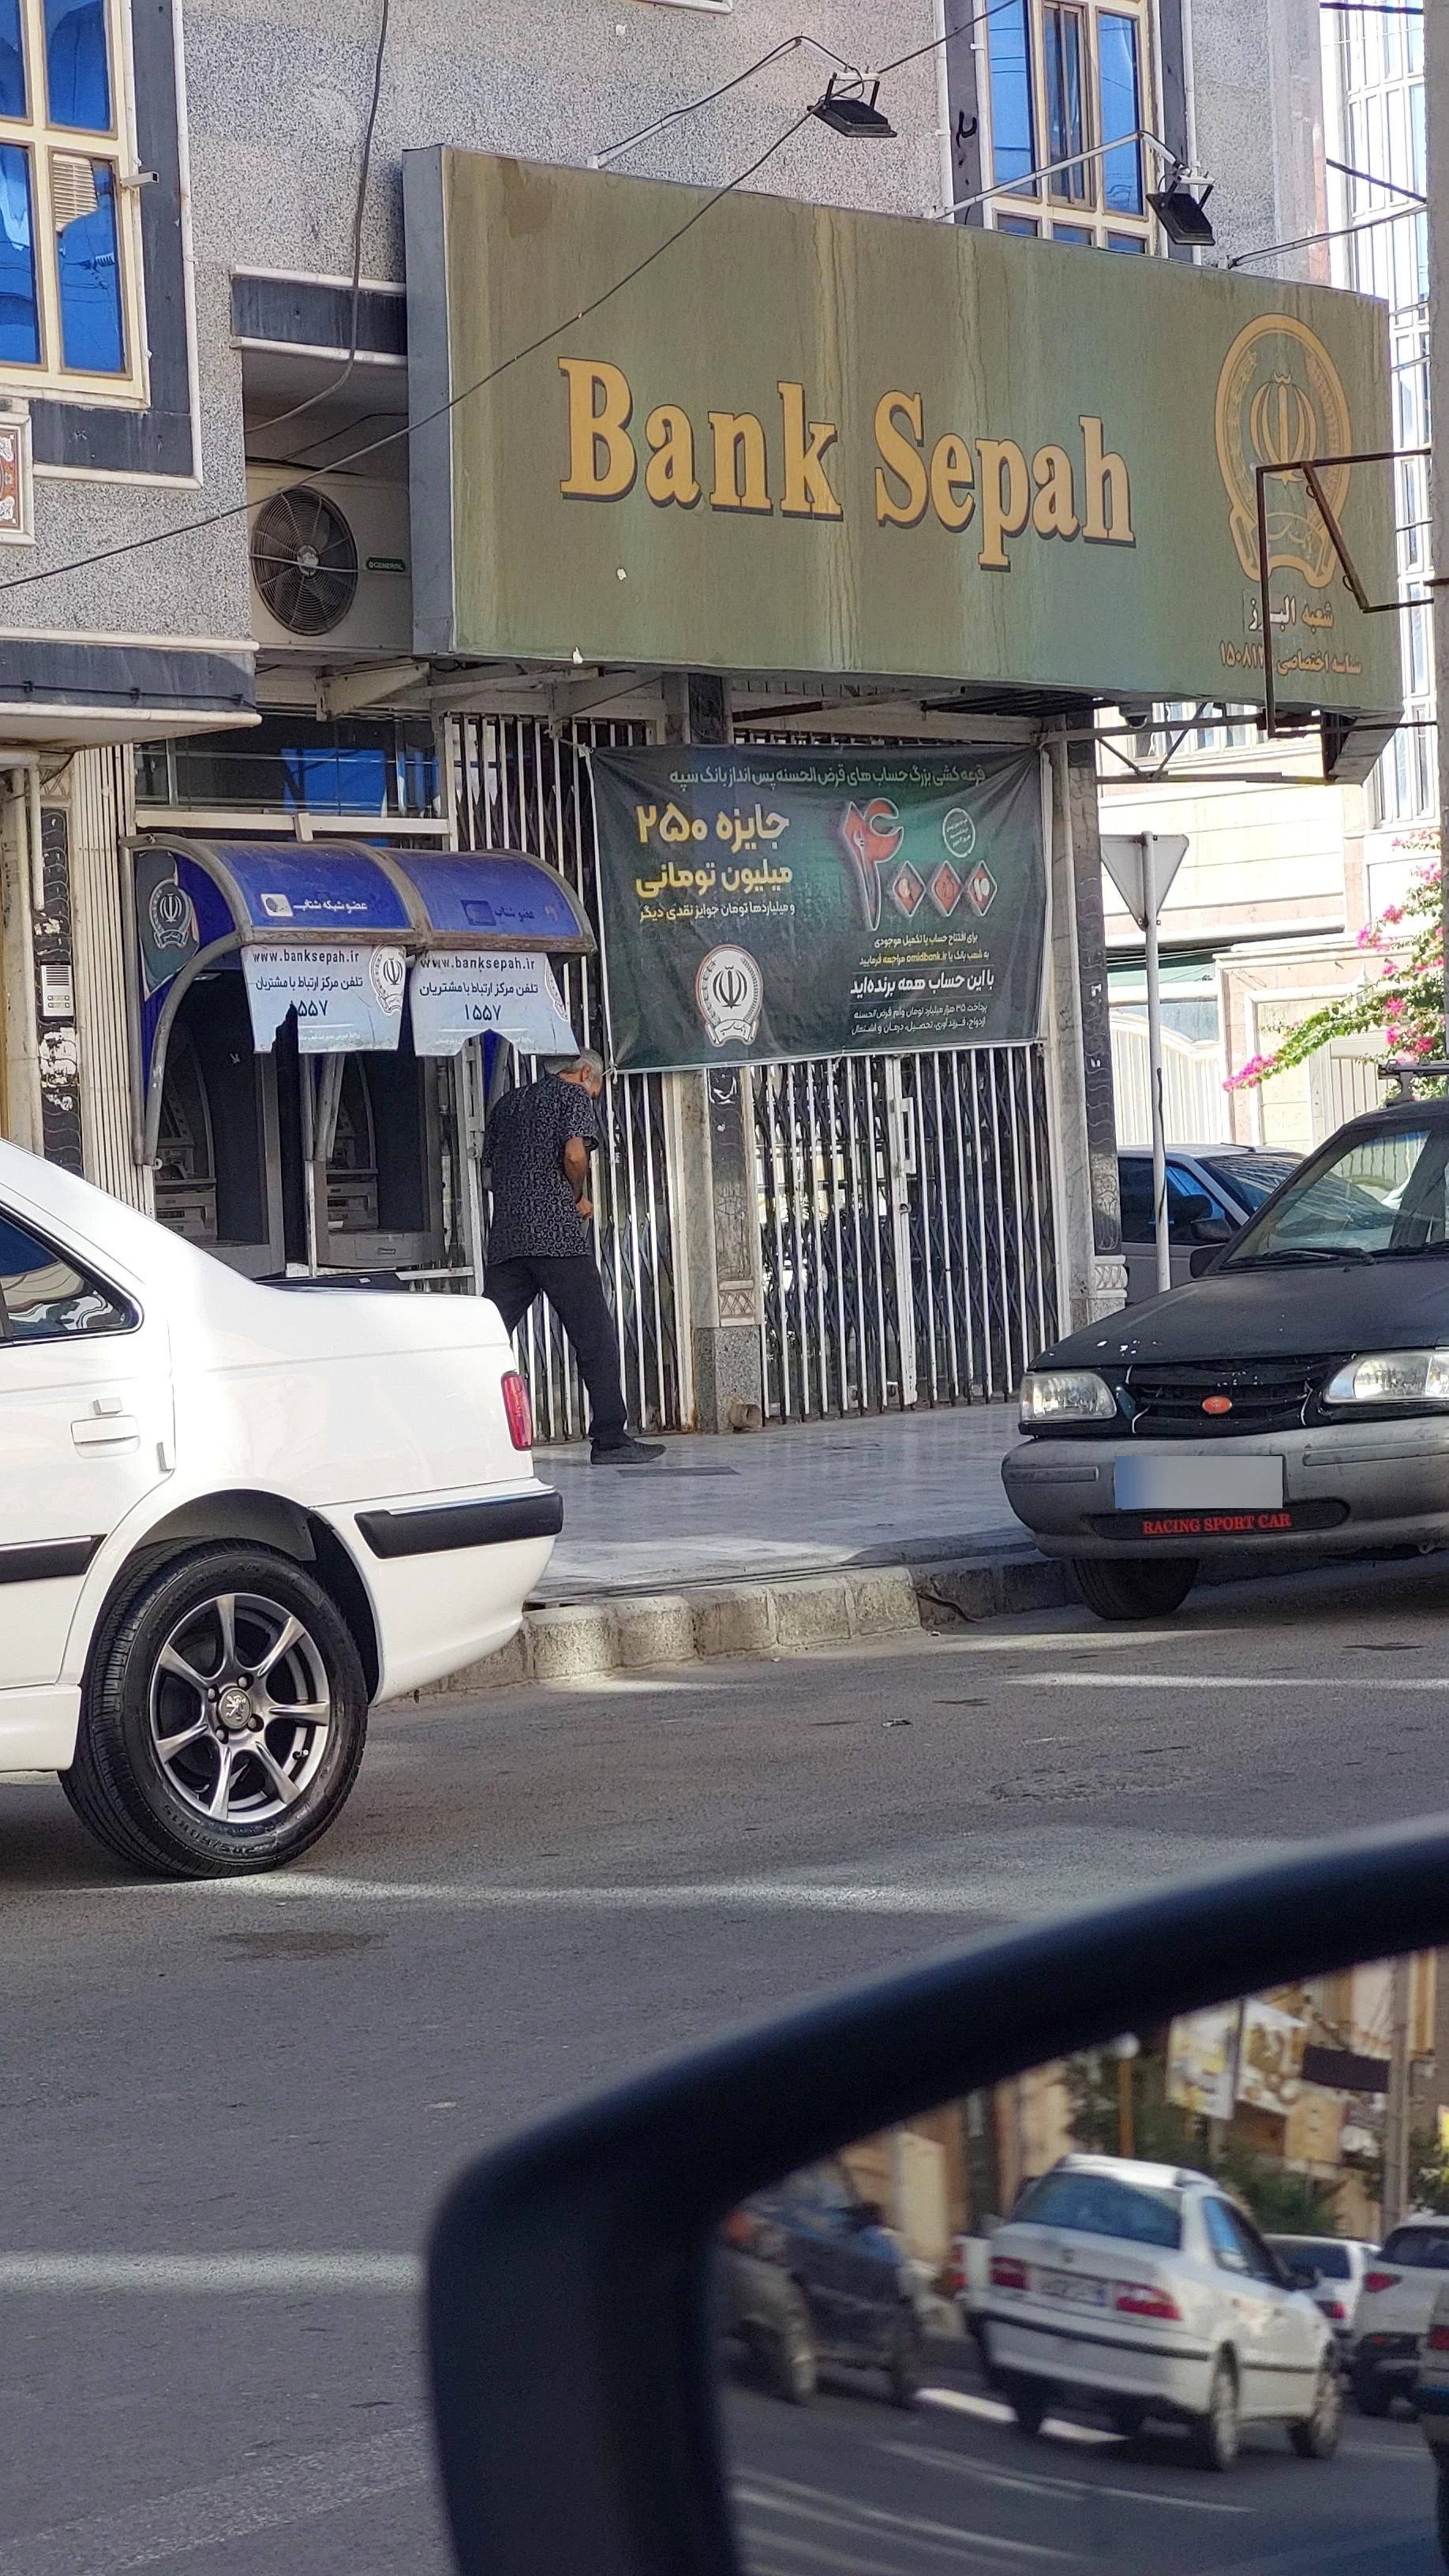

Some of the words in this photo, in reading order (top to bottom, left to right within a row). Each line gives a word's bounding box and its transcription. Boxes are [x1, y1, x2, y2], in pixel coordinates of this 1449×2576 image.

[557, 358, 842, 519] Bank
[874, 387, 1136, 571] Sepah
[1301, 601, 1334, 634] شعبه
[1276, 649, 1329, 676] اختصاصی
[669, 772, 698, 790] سپه
[701, 766, 727, 787] بانک
[728, 766, 754, 787] انداز
[754, 773, 777, 789] پس
[776, 766, 819, 784] الحسنه
[818, 765, 845, 787] قرض
[848, 766, 871, 787] های
[874, 766, 908, 787] حساب
[908, 766, 933, 787] بزرگ
[934, 765, 960, 787] کشی
[961, 764, 985, 786] قرعه
[636, 802, 708, 843] ۲۵۰
[716, 803, 789, 853] جایزه
[635, 862, 716, 898] تومانی
[721, 859, 793, 894] میلیون
[293, 899, 321, 912] شتاب
[323, 898, 346, 911] شبکه
[347, 902, 368, 913] عضو
[666, 904, 693, 920] نقدی
[721, 903, 748, 917] تومان
[639, 905, 665, 922] دیگر
[874, 938, 902, 948] موجودی
[253, 949, 360, 965] www.banksepah.ir
[420, 956, 534, 972] www.banksepah.ir
[255, 975, 287, 990] مشتریان
[290, 978, 295, 990] با
[298, 976, 319, 990] ارتباط
[320, 978, 339, 991] مرکز
[341, 977, 363, 990] تلفن
[420, 981, 462, 995] مشتریان
[516, 983, 538, 994] تلفن
[897, 978, 926, 990] همه
[928, 972, 964, 994] حساب
[967, 970, 986, 991] این
[987, 970, 994, 990] با
[464, 983, 470, 996] با
[472, 983, 492, 996] ارتباط
[495, 983, 514, 996] مرکز
[290, 1000, 328, 1017] ۵۵۷
[465, 1004, 501, 1020] ۱۵۵۷
[1143, 1518, 1200, 1535] RACING
[1204, 1516, 1256, 1531] SPORT
[1257, 1513, 1291, 1529] CAR
